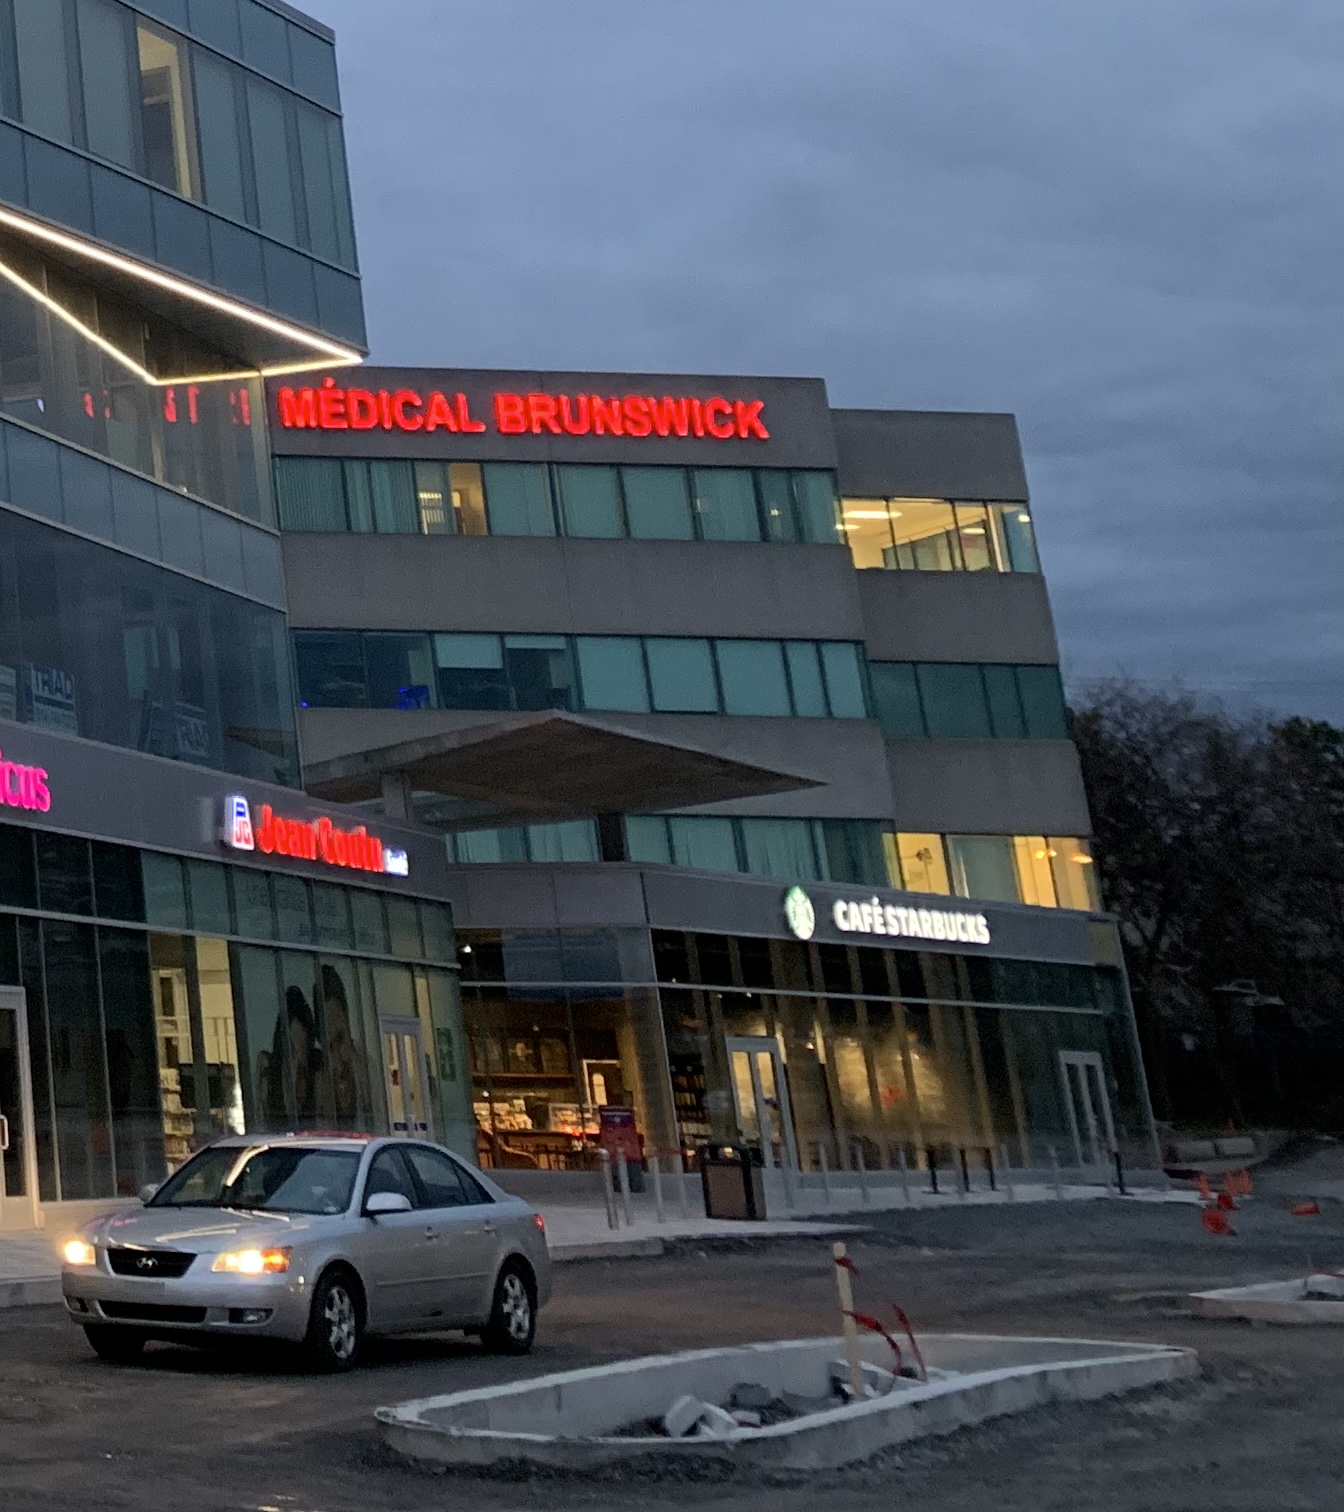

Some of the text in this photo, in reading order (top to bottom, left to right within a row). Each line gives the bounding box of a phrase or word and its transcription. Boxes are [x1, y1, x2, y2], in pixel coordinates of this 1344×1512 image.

[277, 377, 486, 434] MÉDICAL
[494, 392, 771, 440] BRUNSWICK
[257, 804, 317, 860] Jean
[832, 895, 991, 945] CAFÉ STARBUCKS
